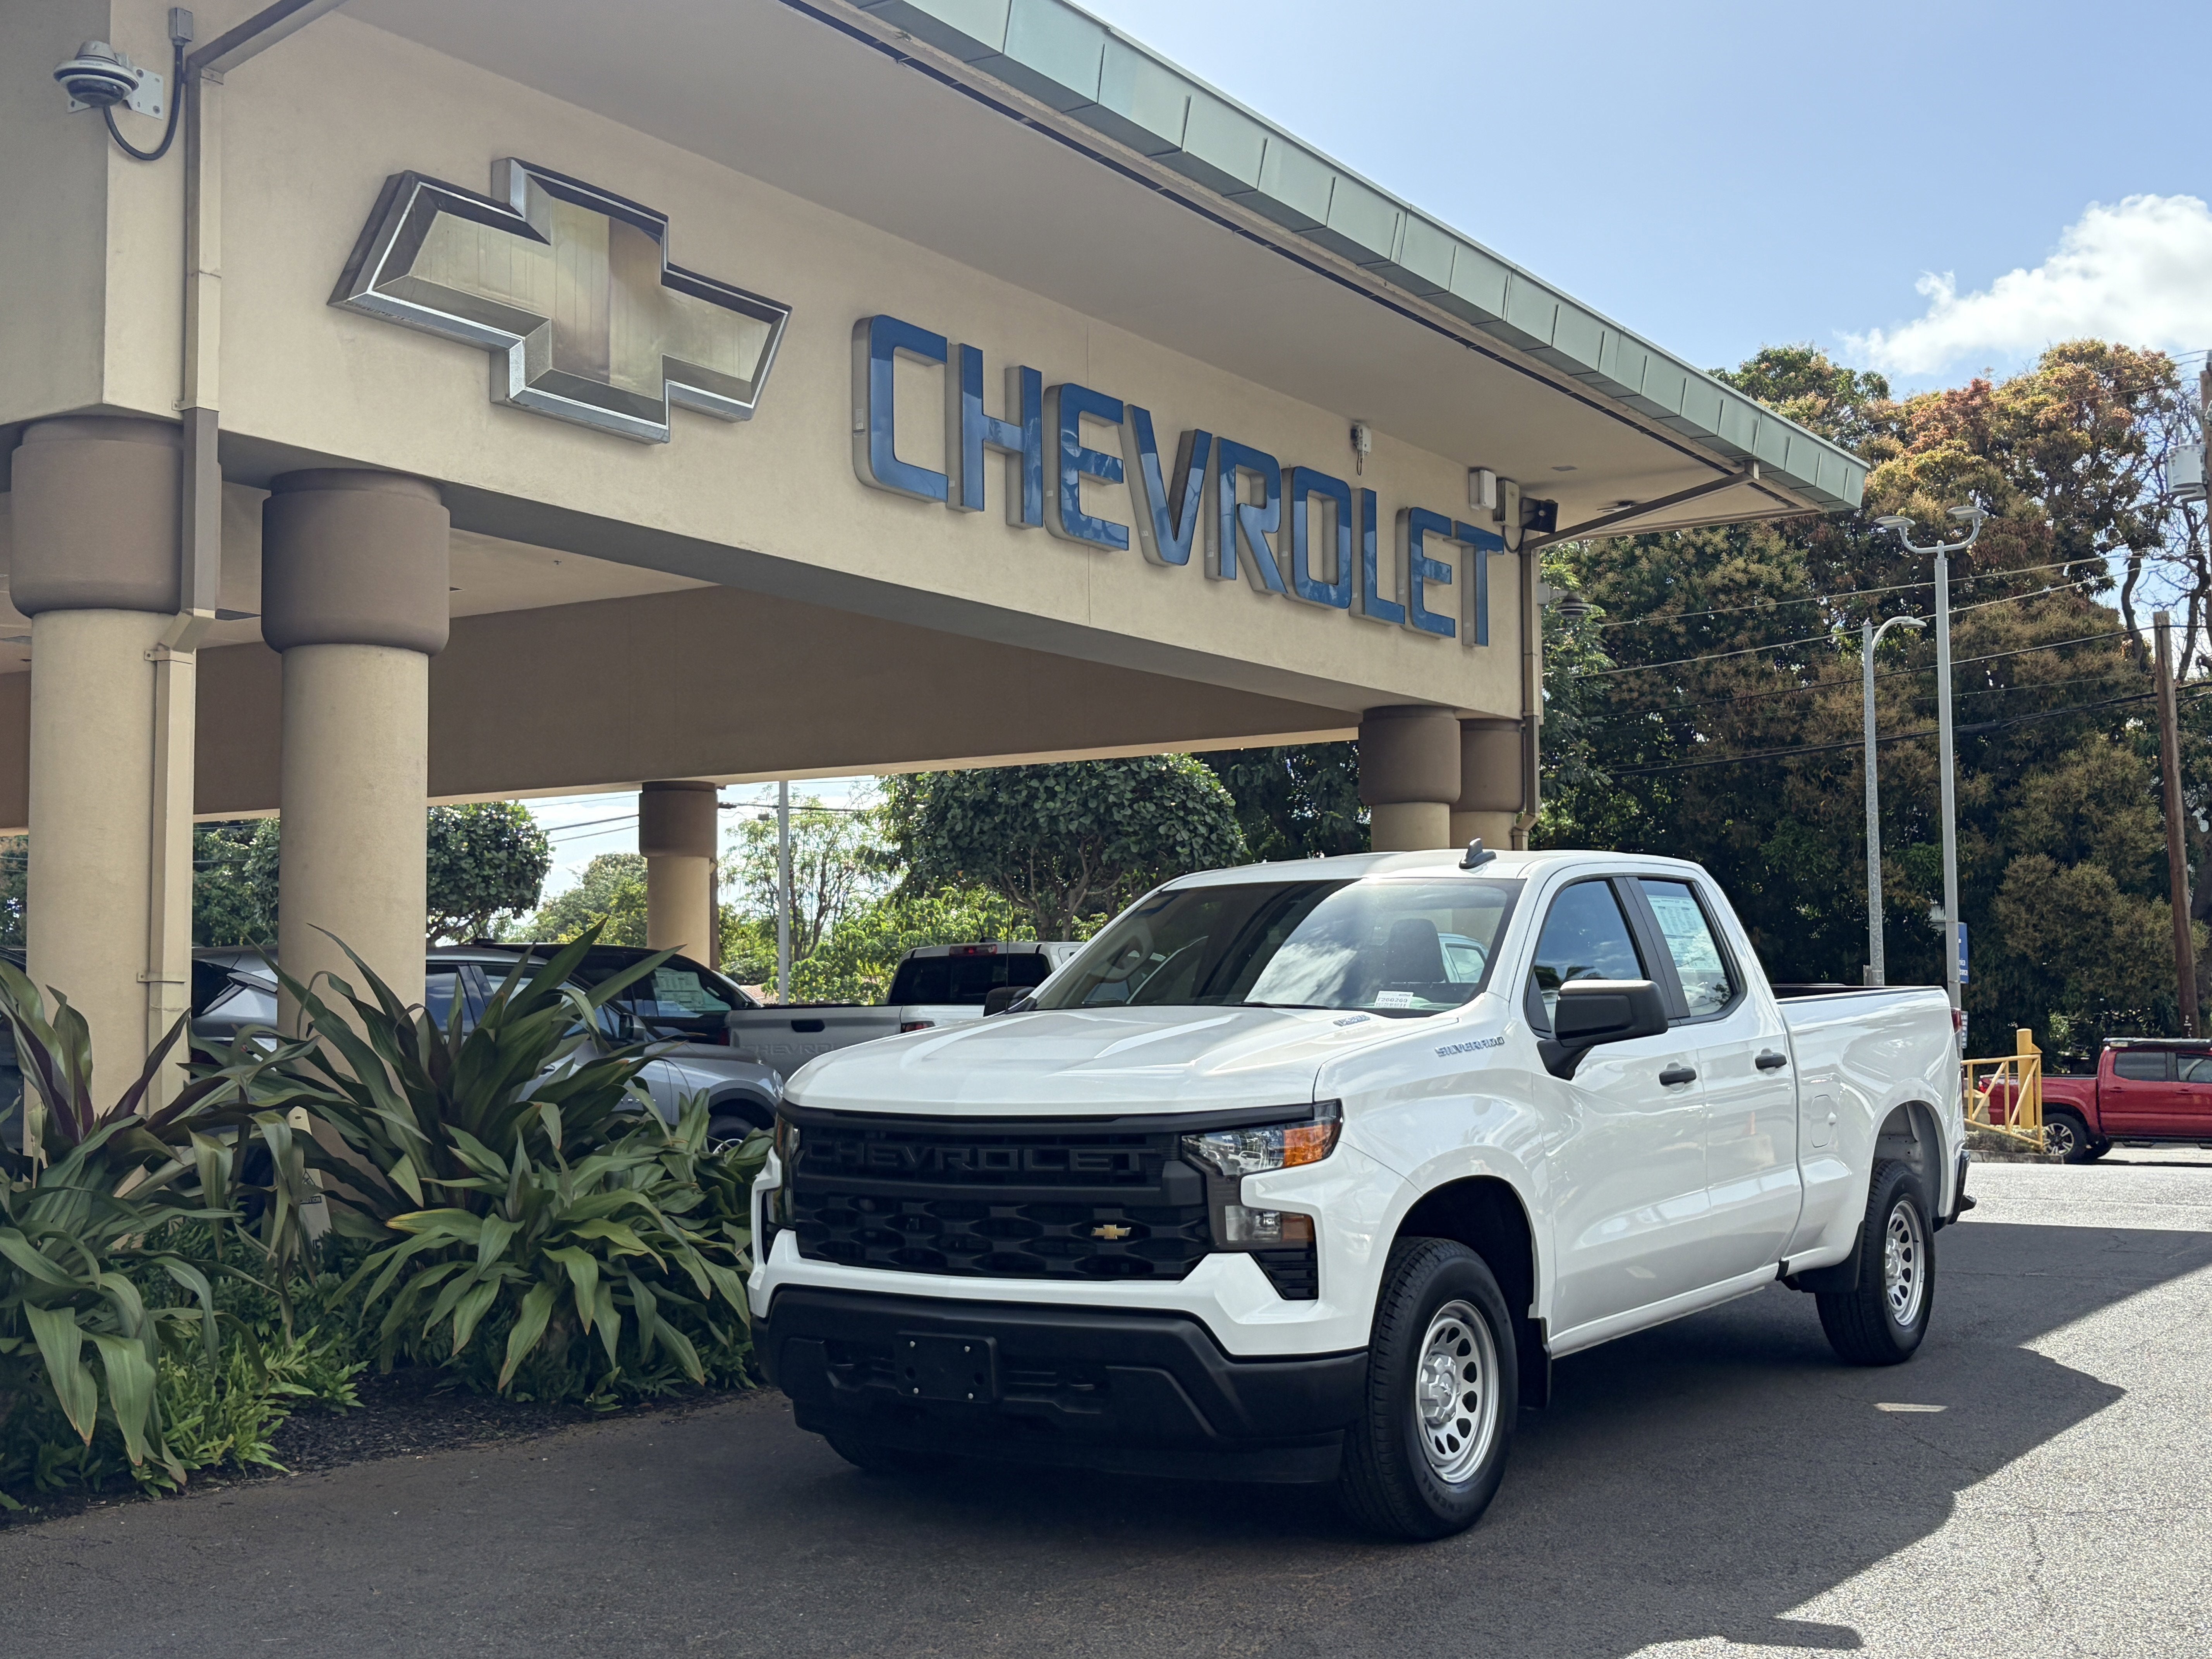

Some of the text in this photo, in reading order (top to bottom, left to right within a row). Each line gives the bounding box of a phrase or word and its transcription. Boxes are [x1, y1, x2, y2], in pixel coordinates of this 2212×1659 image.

[852, 314, 1504, 647] CHEVROLET
[1434, 1036, 1505, 1057] SILVERADO
[805, 1138, 1159, 1173] CHEVROLET
